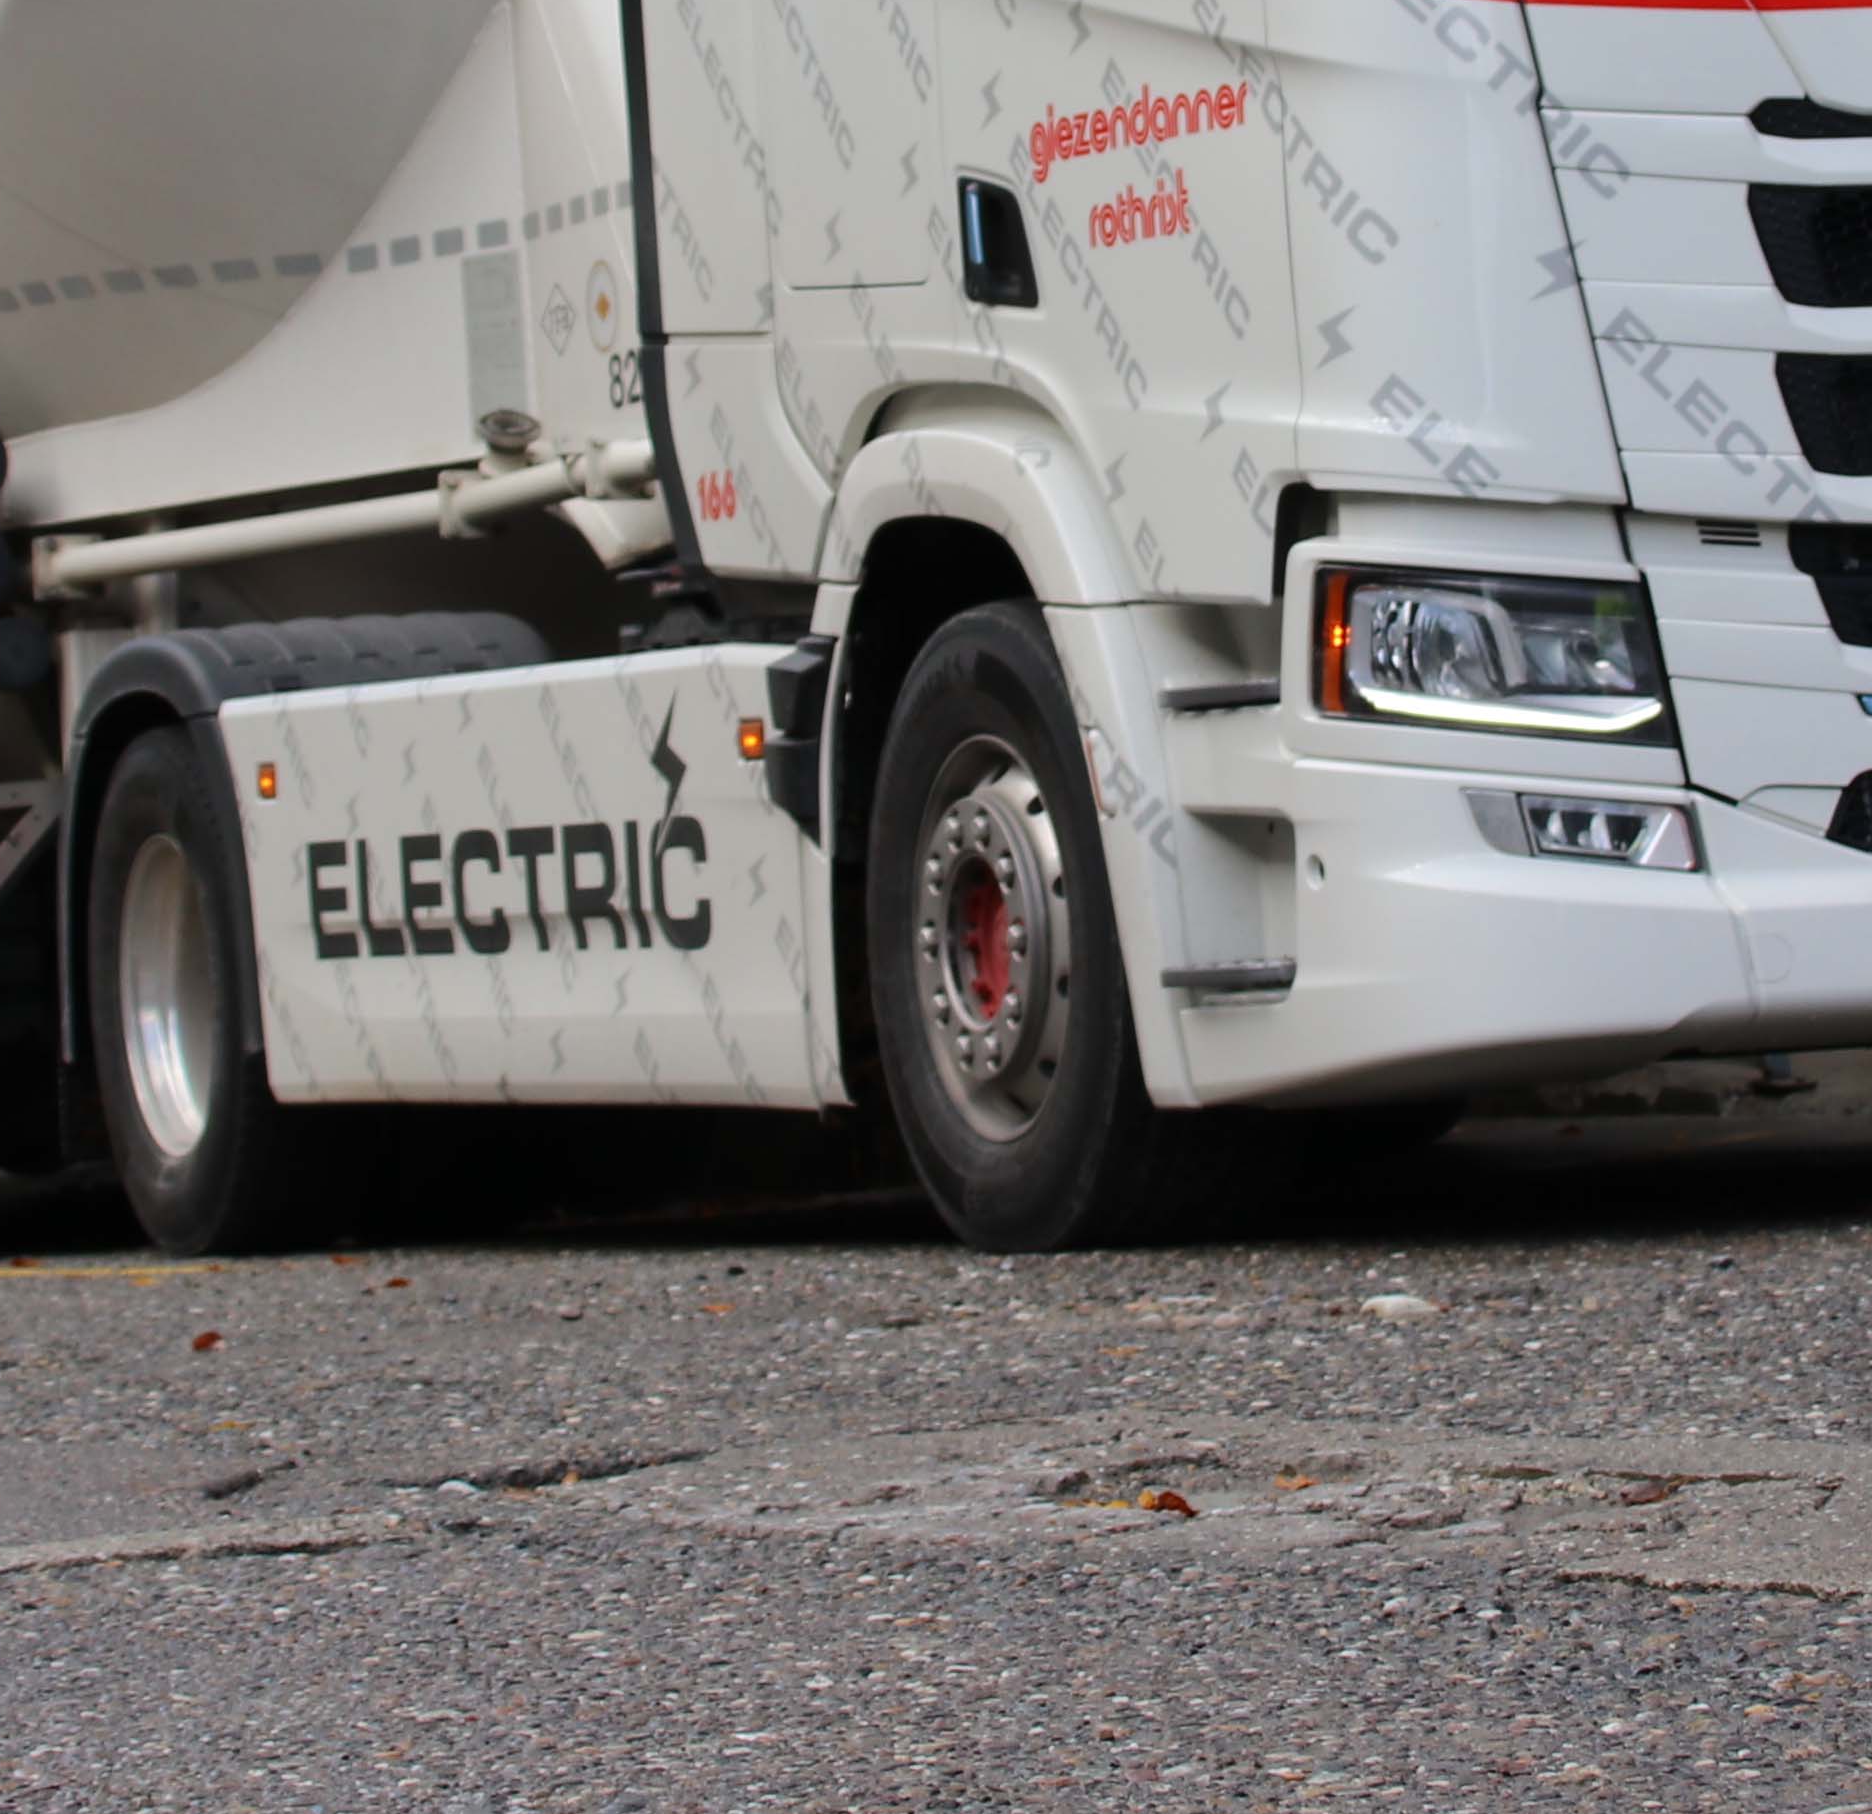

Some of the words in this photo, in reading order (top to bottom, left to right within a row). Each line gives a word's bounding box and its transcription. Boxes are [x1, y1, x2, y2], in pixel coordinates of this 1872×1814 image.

[1029, 82, 1249, 183] giezendanner
[1088, 168, 1192, 250] rothrist
[1368, 372, 1502, 499] ELE
[697, 469, 738, 522] 166
[307, 815, 712, 961] ELECTRIC
